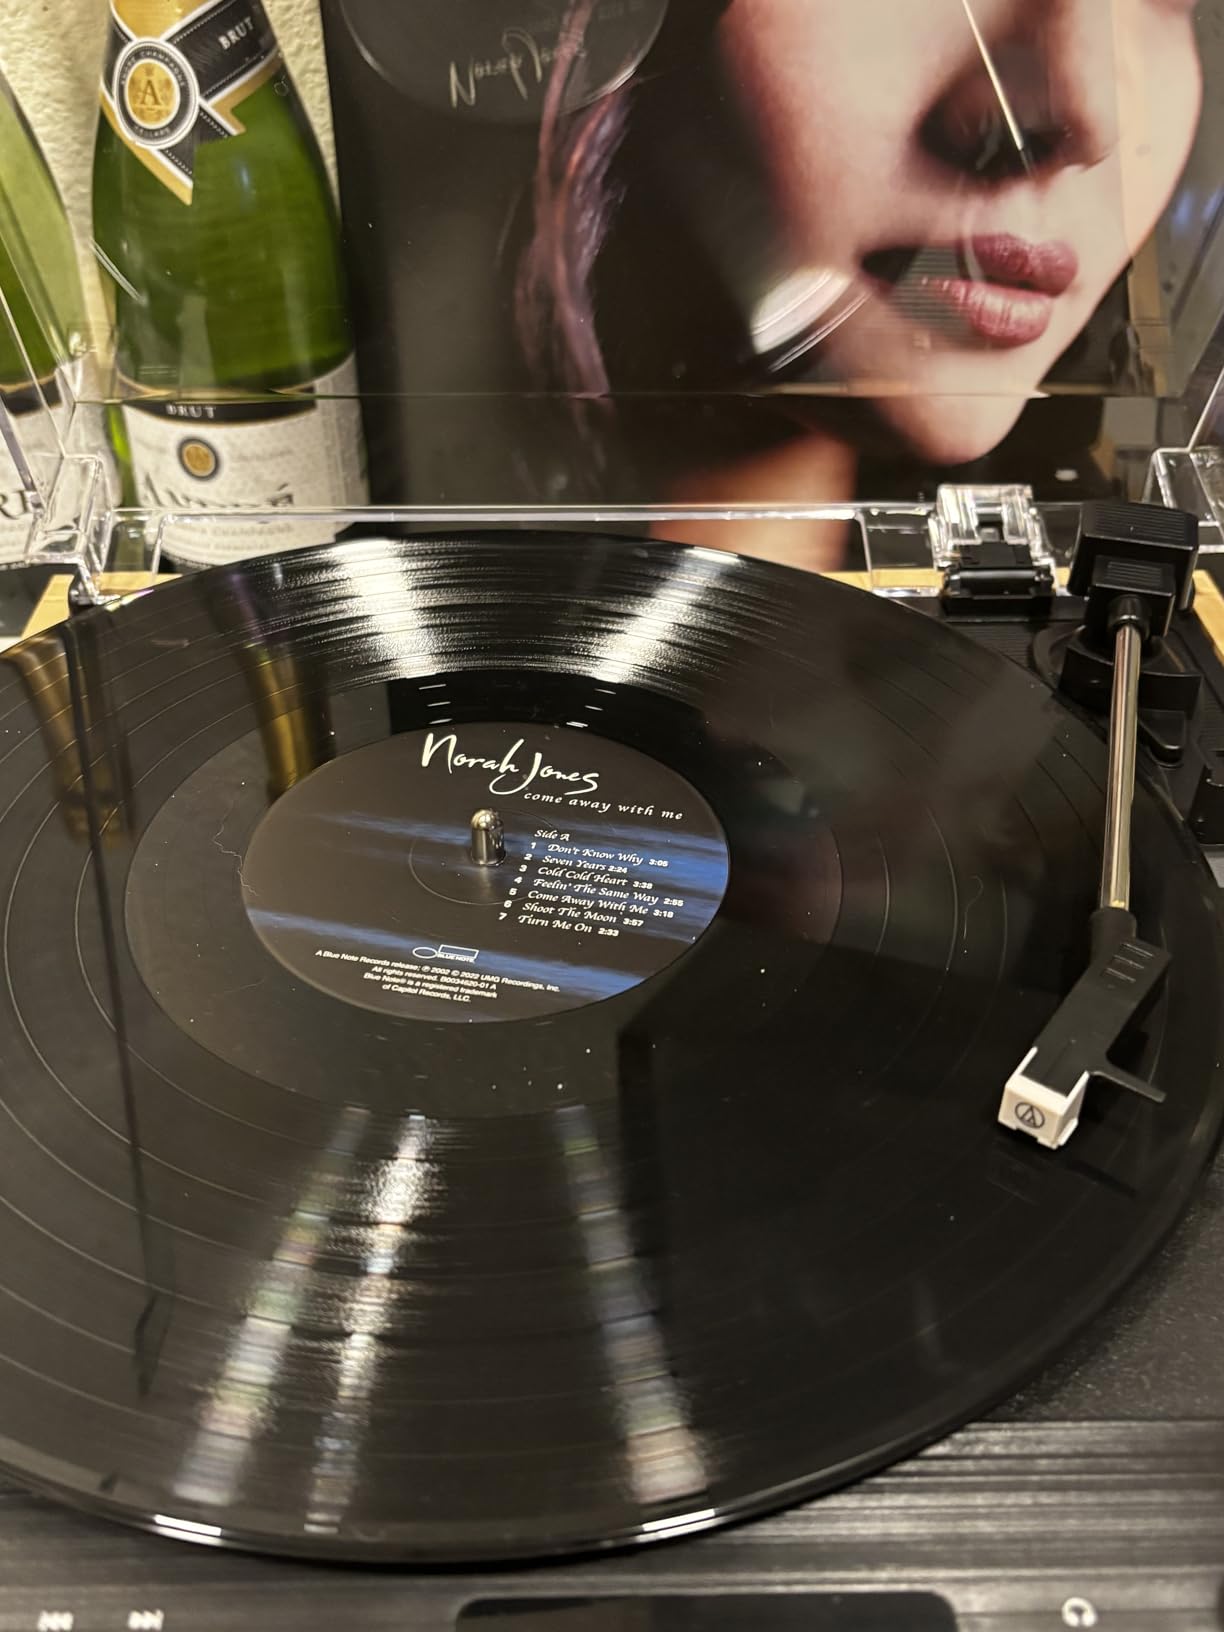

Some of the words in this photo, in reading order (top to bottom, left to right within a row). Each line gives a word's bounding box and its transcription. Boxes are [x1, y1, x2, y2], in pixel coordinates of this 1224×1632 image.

[218, 16, 255, 50] BRUT
[165, 403, 217, 419] BRUT
[421, 733, 525, 774] Norah
[489, 752, 600, 796] Jones
[524, 791, 562, 803] come
[569, 797, 611, 813] away
[618, 803, 655, 817] with
[661, 810, 683, 820] me
[534, 829, 558, 840] Side
[560, 833, 570, 842] A
[523, 853, 533, 861] 2
[542, 855, 573, 867] Seven
[576, 859, 607, 871] Years
[607, 865, 628, 874] 2:24
[530, 842, 537, 850] 1
[547, 844, 581, 855] Don't
[582, 848, 615, 860] Know
[618, 853, 644, 866] Why
[649, 858, 669, 867] 3:05
[519, 864, 528, 873] 3
[537, 866, 566, 877] Cold
[565, 869, 593, 881] Cold
[593, 873, 628, 886] Heart
[509, 888, 518, 896] 5
[527, 891, 558, 902] Come
[561, 895, 595, 910] Away
[598, 899, 627, 911] With
[629, 904, 649, 914] Me
[653, 909, 674, 918] 3:18
[513, 876, 523, 884] 4
[533, 878, 572, 891] Feelin'
[573, 883, 597, 894] The
[598, 887, 630, 899] Same
[633, 892, 659, 905] Way
[503, 900, 512, 908] 6
[522, 902, 555, 914] Shoot
[557, 906, 581, 918] The
[584, 911, 617, 923] Moon
[623, 918, 644, 927] 3:57
[518, 915, 549, 927] Turn
[552, 919, 572, 930] Me
[574, 923, 592, 933] On
[598, 927, 619, 937] 2:33
[437, 952, 456, 960] BLUE
[455, 954, 476, 963] NOTE
[323, 950, 340, 959] Blue
[341, 953, 359, 962] Note
[359, 956, 391, 967] Records
[431, 966, 450, 976] 2002
[480, 974, 500, 983] UMG
[501, 977, 545, 990] Recordings,
[546, 984, 560, 992] Inc.
[382, 967, 404, 976] rights
[404, 970, 438, 981] reserved.
[363, 972, 382, 981] Blue
[421, 980, 459, 993] registered
[459, 986, 498, 999] trademark
[391, 984, 419, 995] Capitol
[418, 988, 452, 1000] Records,
[453, 994, 472, 1002] LLC.
